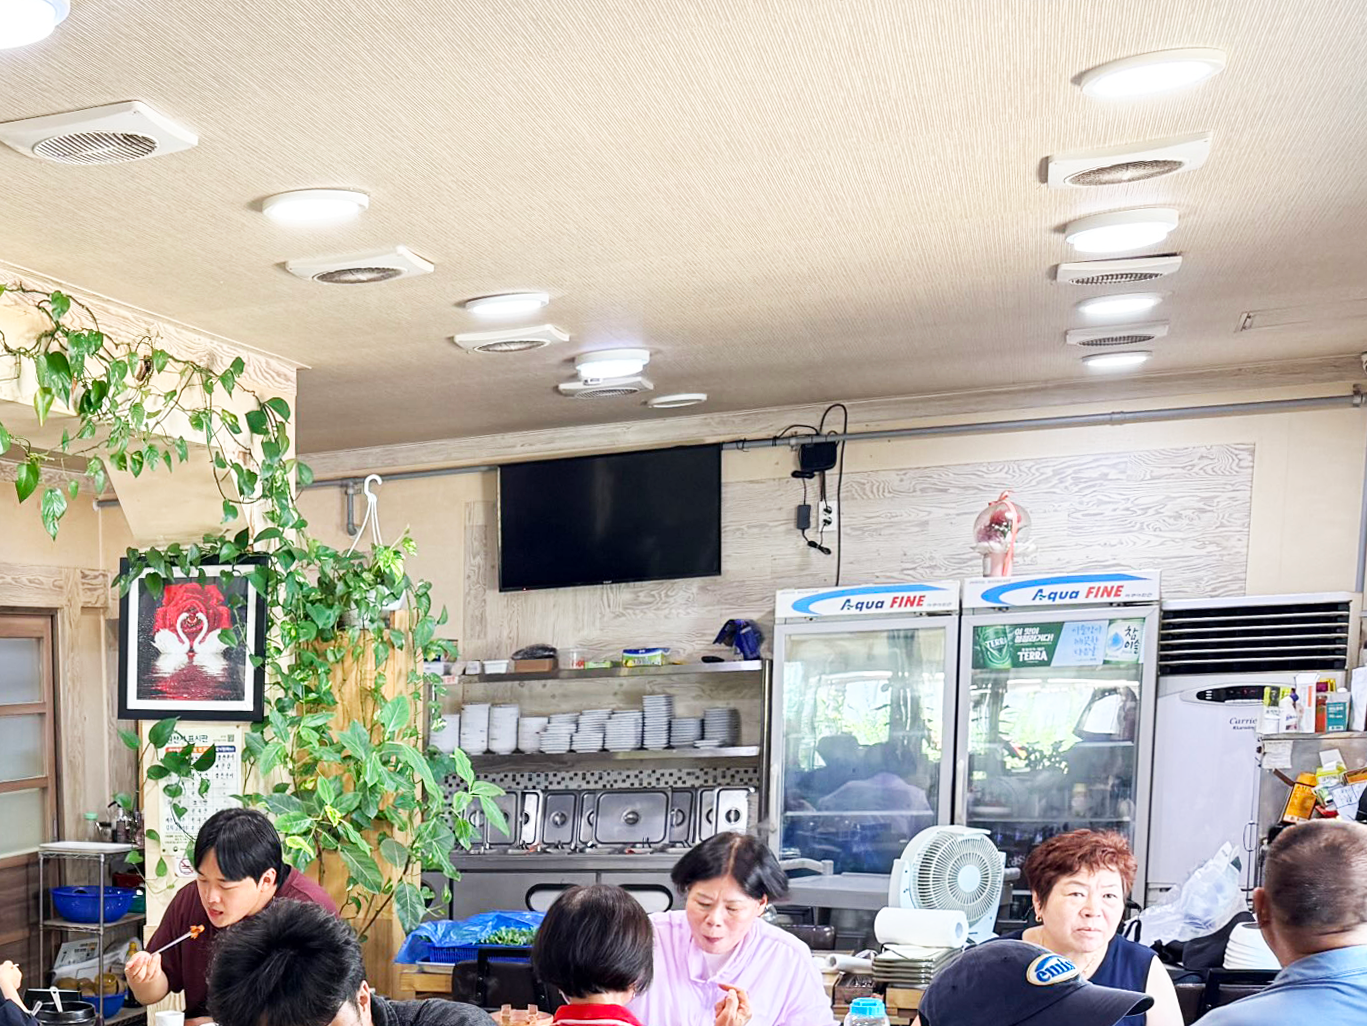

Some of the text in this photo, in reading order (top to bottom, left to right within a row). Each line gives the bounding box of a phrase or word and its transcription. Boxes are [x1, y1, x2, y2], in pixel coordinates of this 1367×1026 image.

[1032, 588, 1079, 602] Aqua
[1085, 585, 1124, 599] FINE
[840, 598, 884, 612] Aqua
[890, 595, 926, 608] FINE
[1017, 651, 1048, 662] TERRA
[1229, 717, 1258, 725] Carrie
